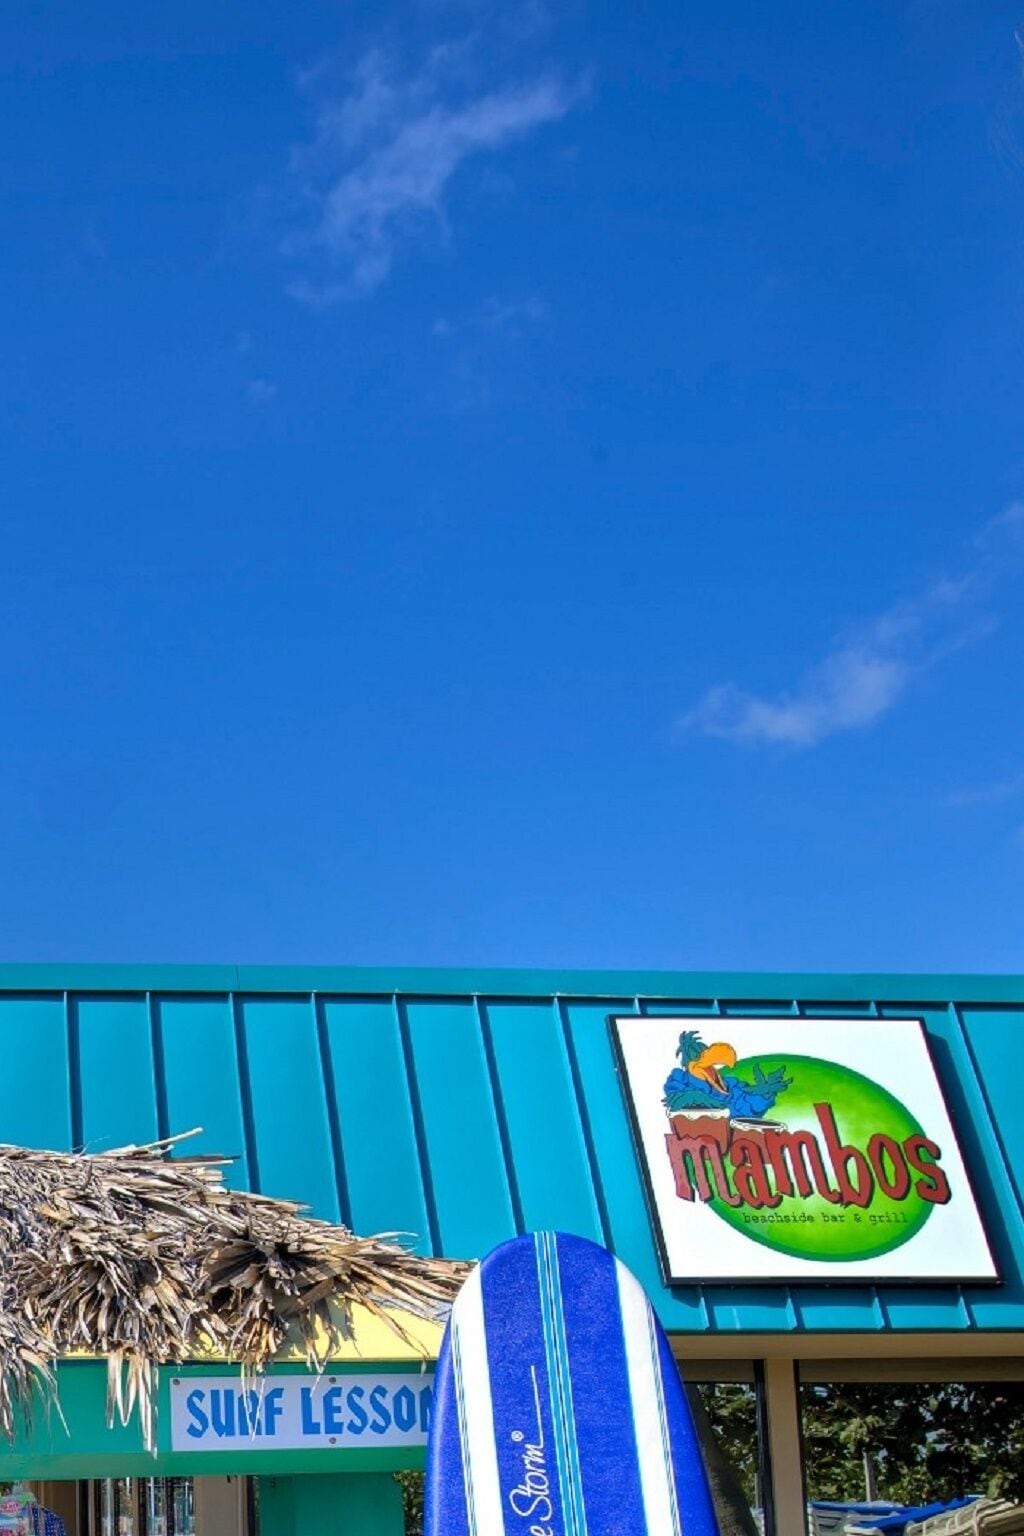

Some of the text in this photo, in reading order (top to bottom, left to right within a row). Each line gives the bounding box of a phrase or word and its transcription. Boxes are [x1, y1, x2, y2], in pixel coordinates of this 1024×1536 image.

[664, 1102, 952, 1209] mambos
[742, 1212, 909, 1226] beachside bar & grill
[186, 1387, 285, 1438] SURF
